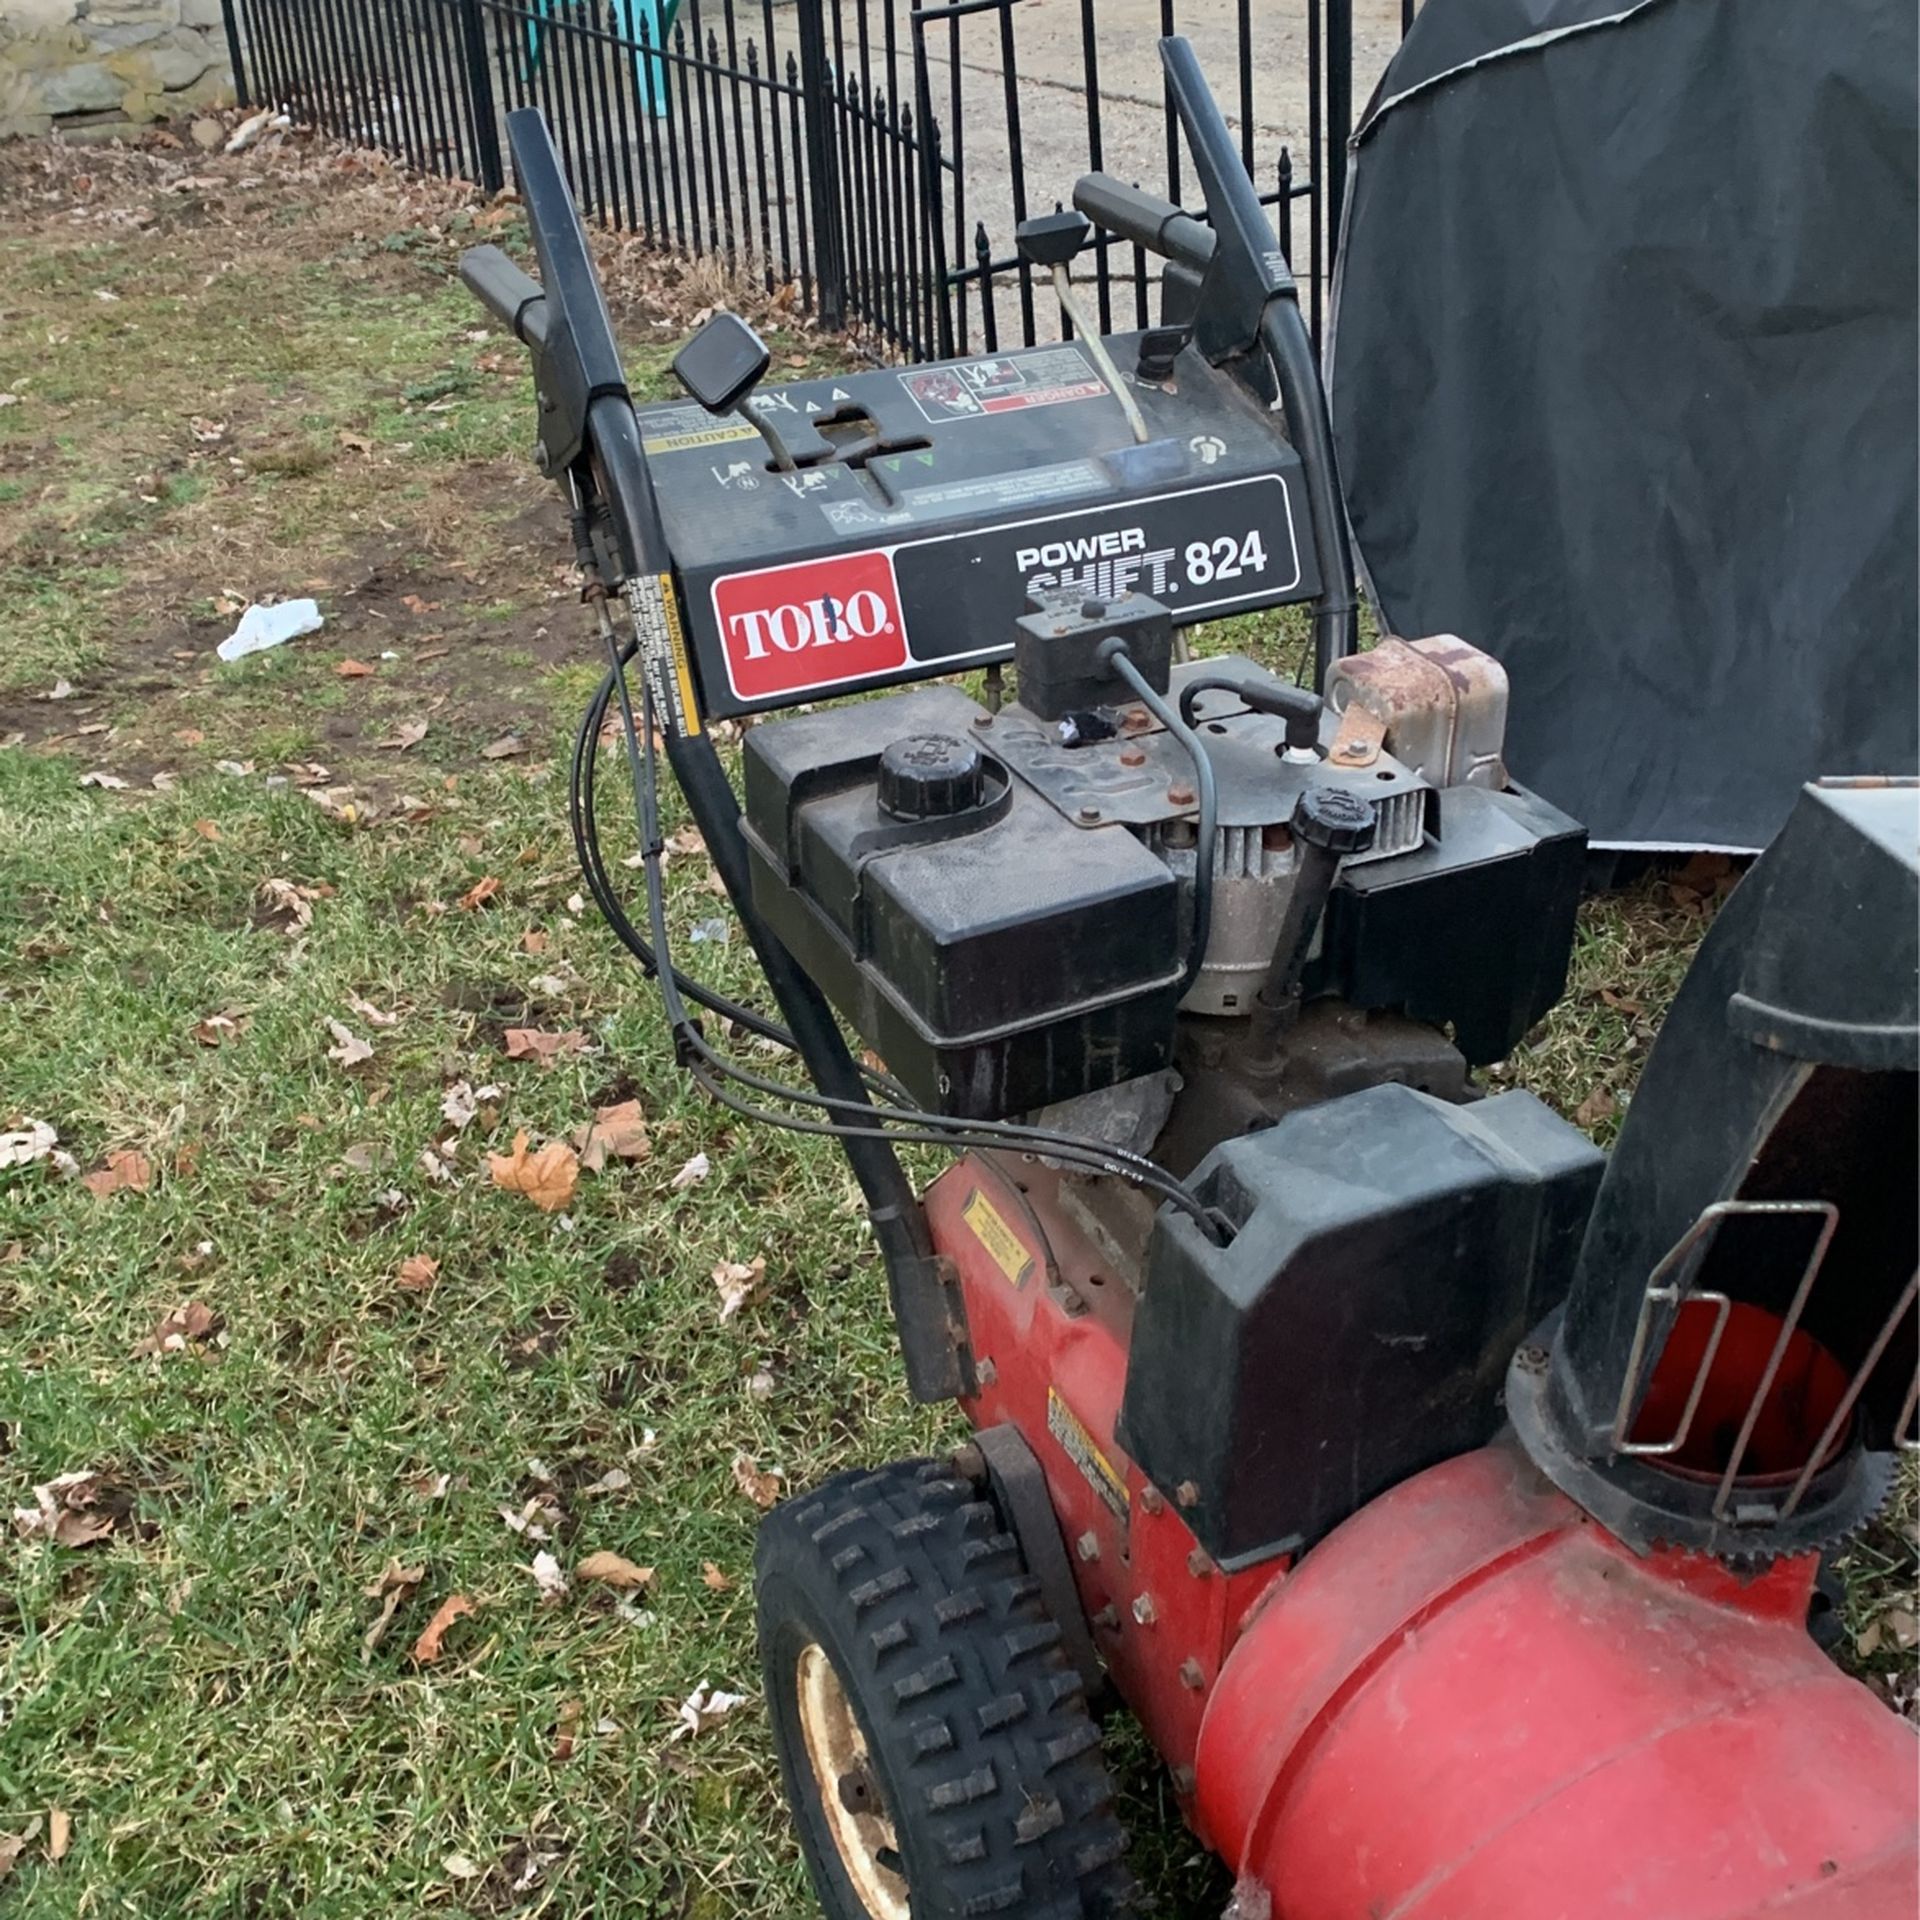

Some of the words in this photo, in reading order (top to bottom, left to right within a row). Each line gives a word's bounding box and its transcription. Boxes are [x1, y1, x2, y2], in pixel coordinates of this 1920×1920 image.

[1024, 386, 1086, 405] DANGER
[666, 429, 737, 447] CAUTION
[1016, 527, 1146, 572] POWER
[1185, 530, 1267, 585] 824
[666, 600, 683, 668] WARNING
